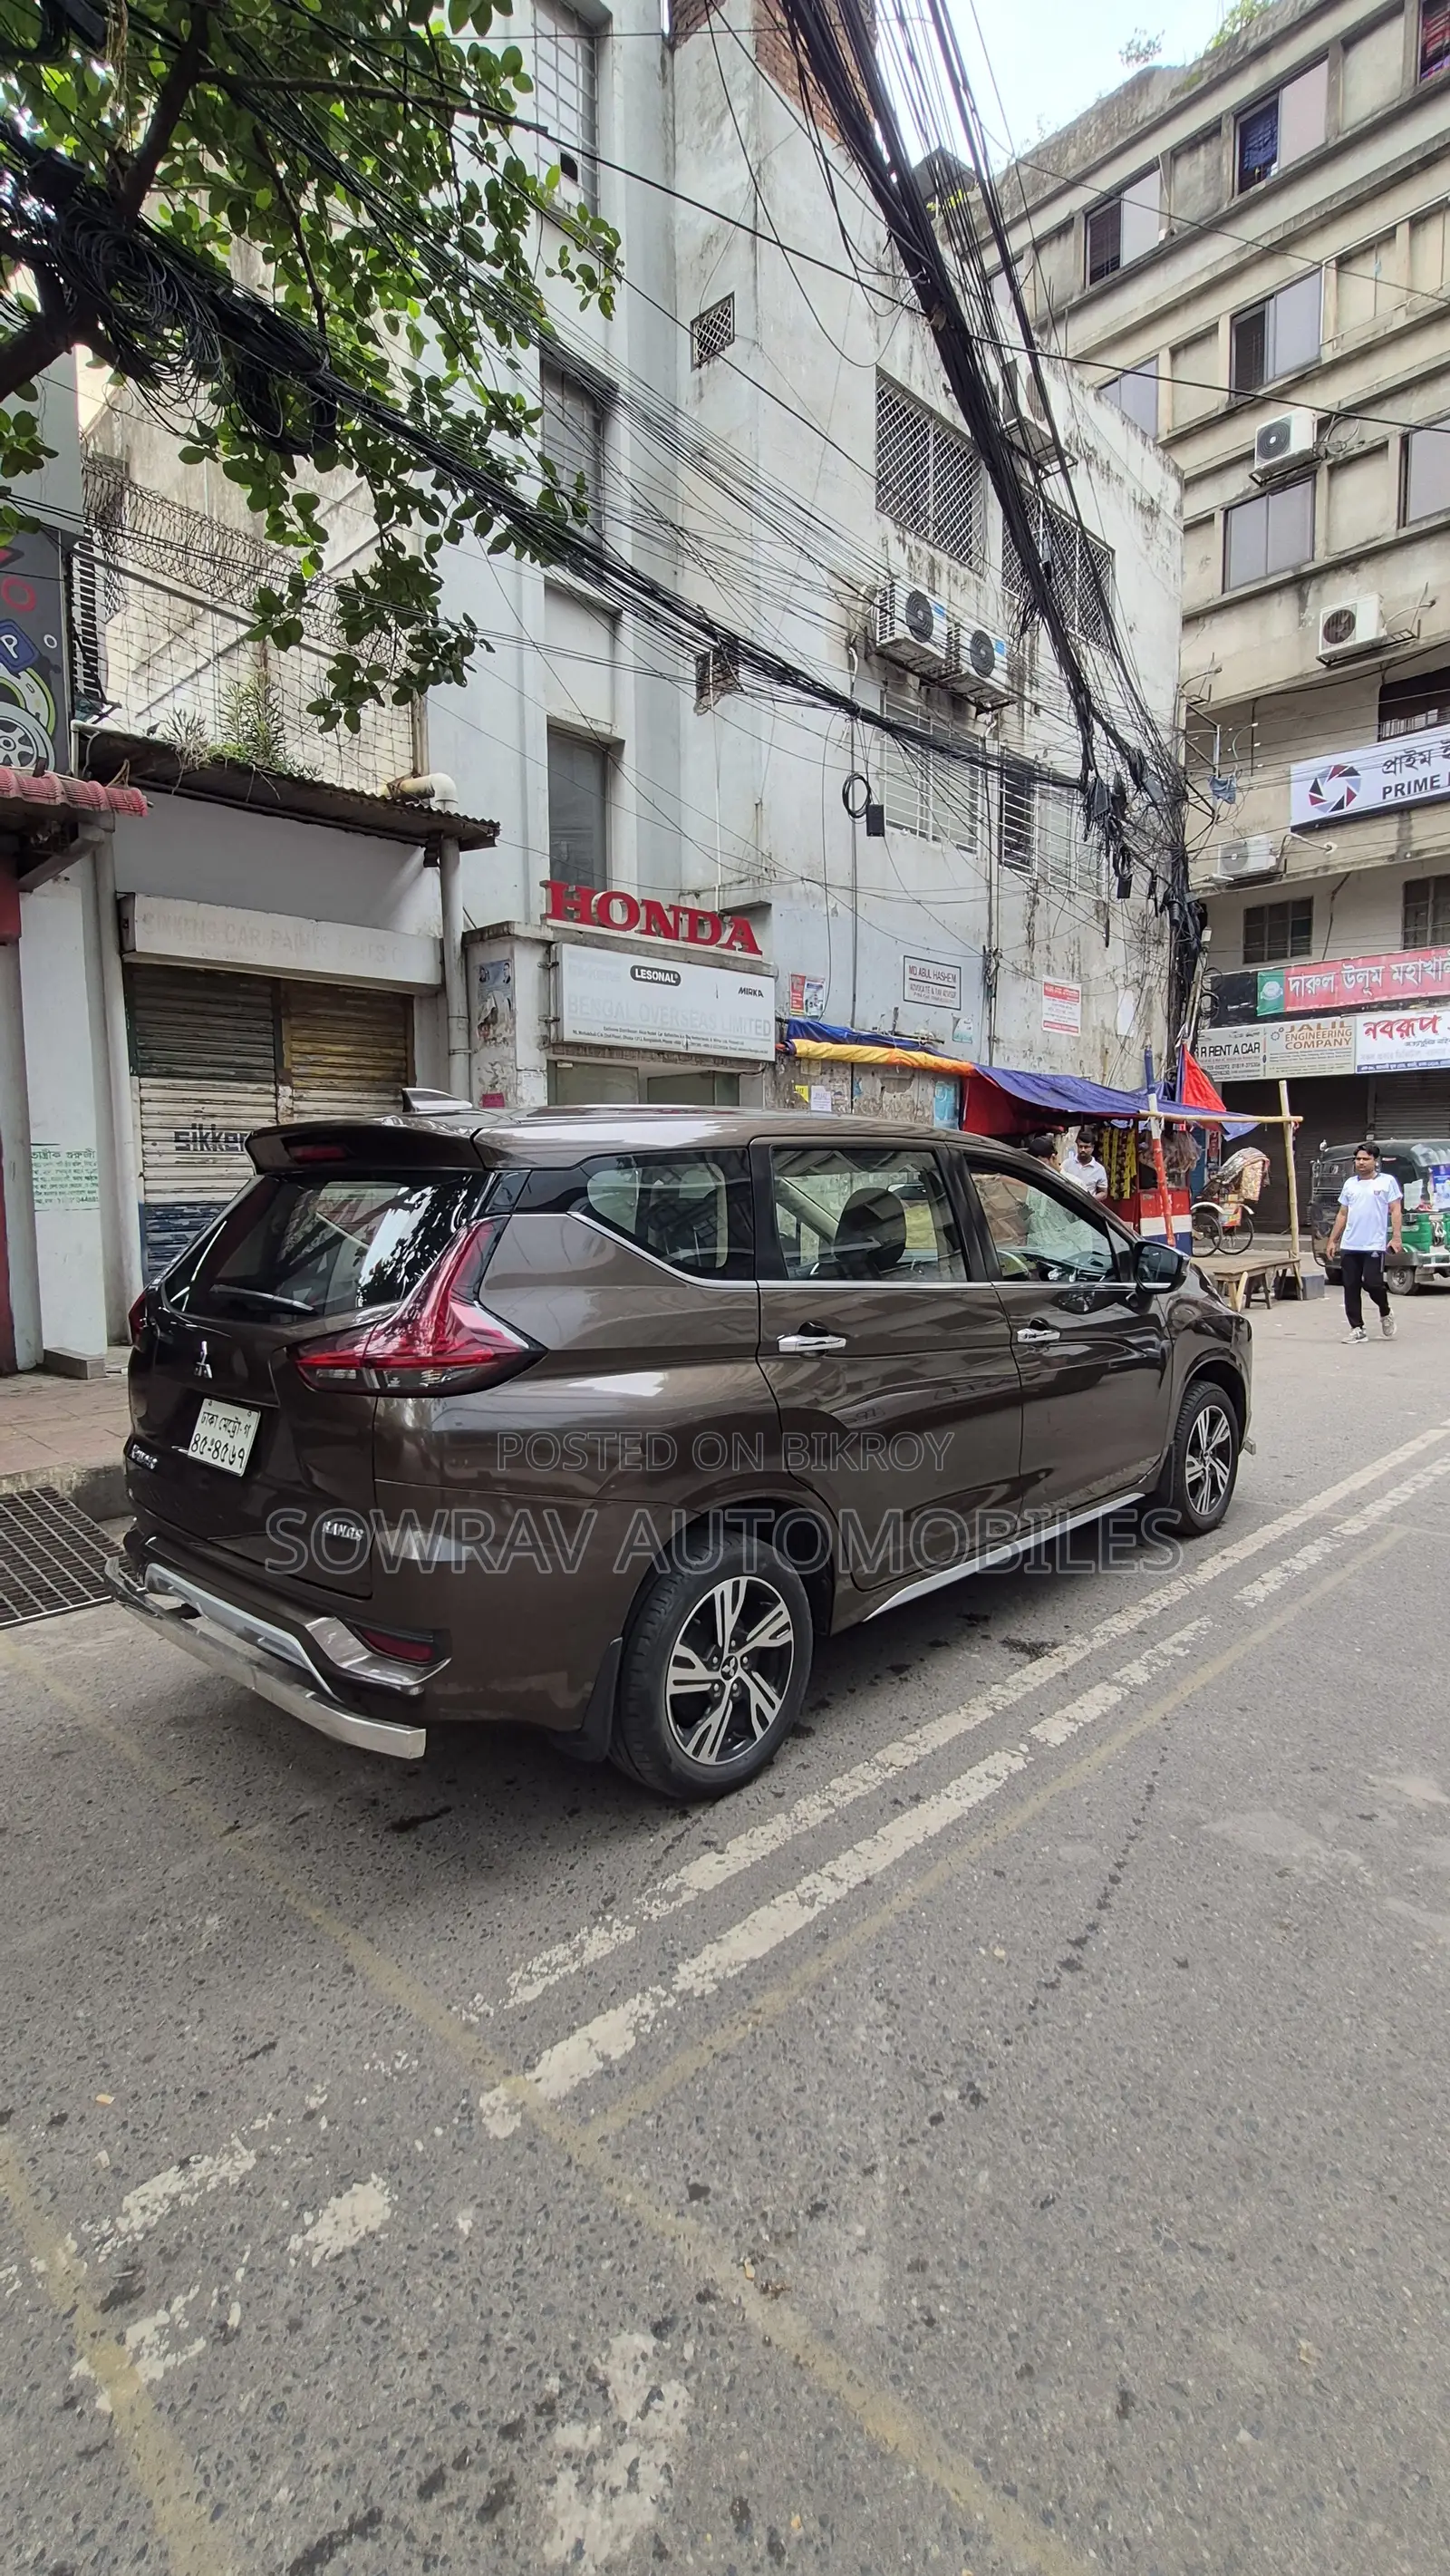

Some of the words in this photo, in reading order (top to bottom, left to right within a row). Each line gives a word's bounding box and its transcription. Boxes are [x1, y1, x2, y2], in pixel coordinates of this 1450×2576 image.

[1382, 750, 1434, 776] প্রাইম
[1382, 774, 1441, 799] PRIME
[545, 880, 762, 955] HONDA
[634, 967, 677, 983] LESONAL
[1288, 972, 1338, 998] দারুল
[1341, 963, 1386, 996] উলূম
[738, 986, 764, 998] MIRKA
[567, 996, 633, 1021] BENGAL
[638, 1003, 717, 1031] OVERSEAS
[720, 1013, 771, 1037] LIMITED
[1285, 1029, 1352, 1042] ENGINEERING
[1286, 1021, 1352, 1033] JALIL
[1363, 1015, 1443, 1040] নবরূপ
[1208, 1044, 1232, 1058] RENT
[1233, 1043, 1240, 1055] A
[1242, 1041, 1261, 1054] CAR
[1285, 1038, 1351, 1051] COMPANY
[201, 1411, 218, 1428] ঢাকা
